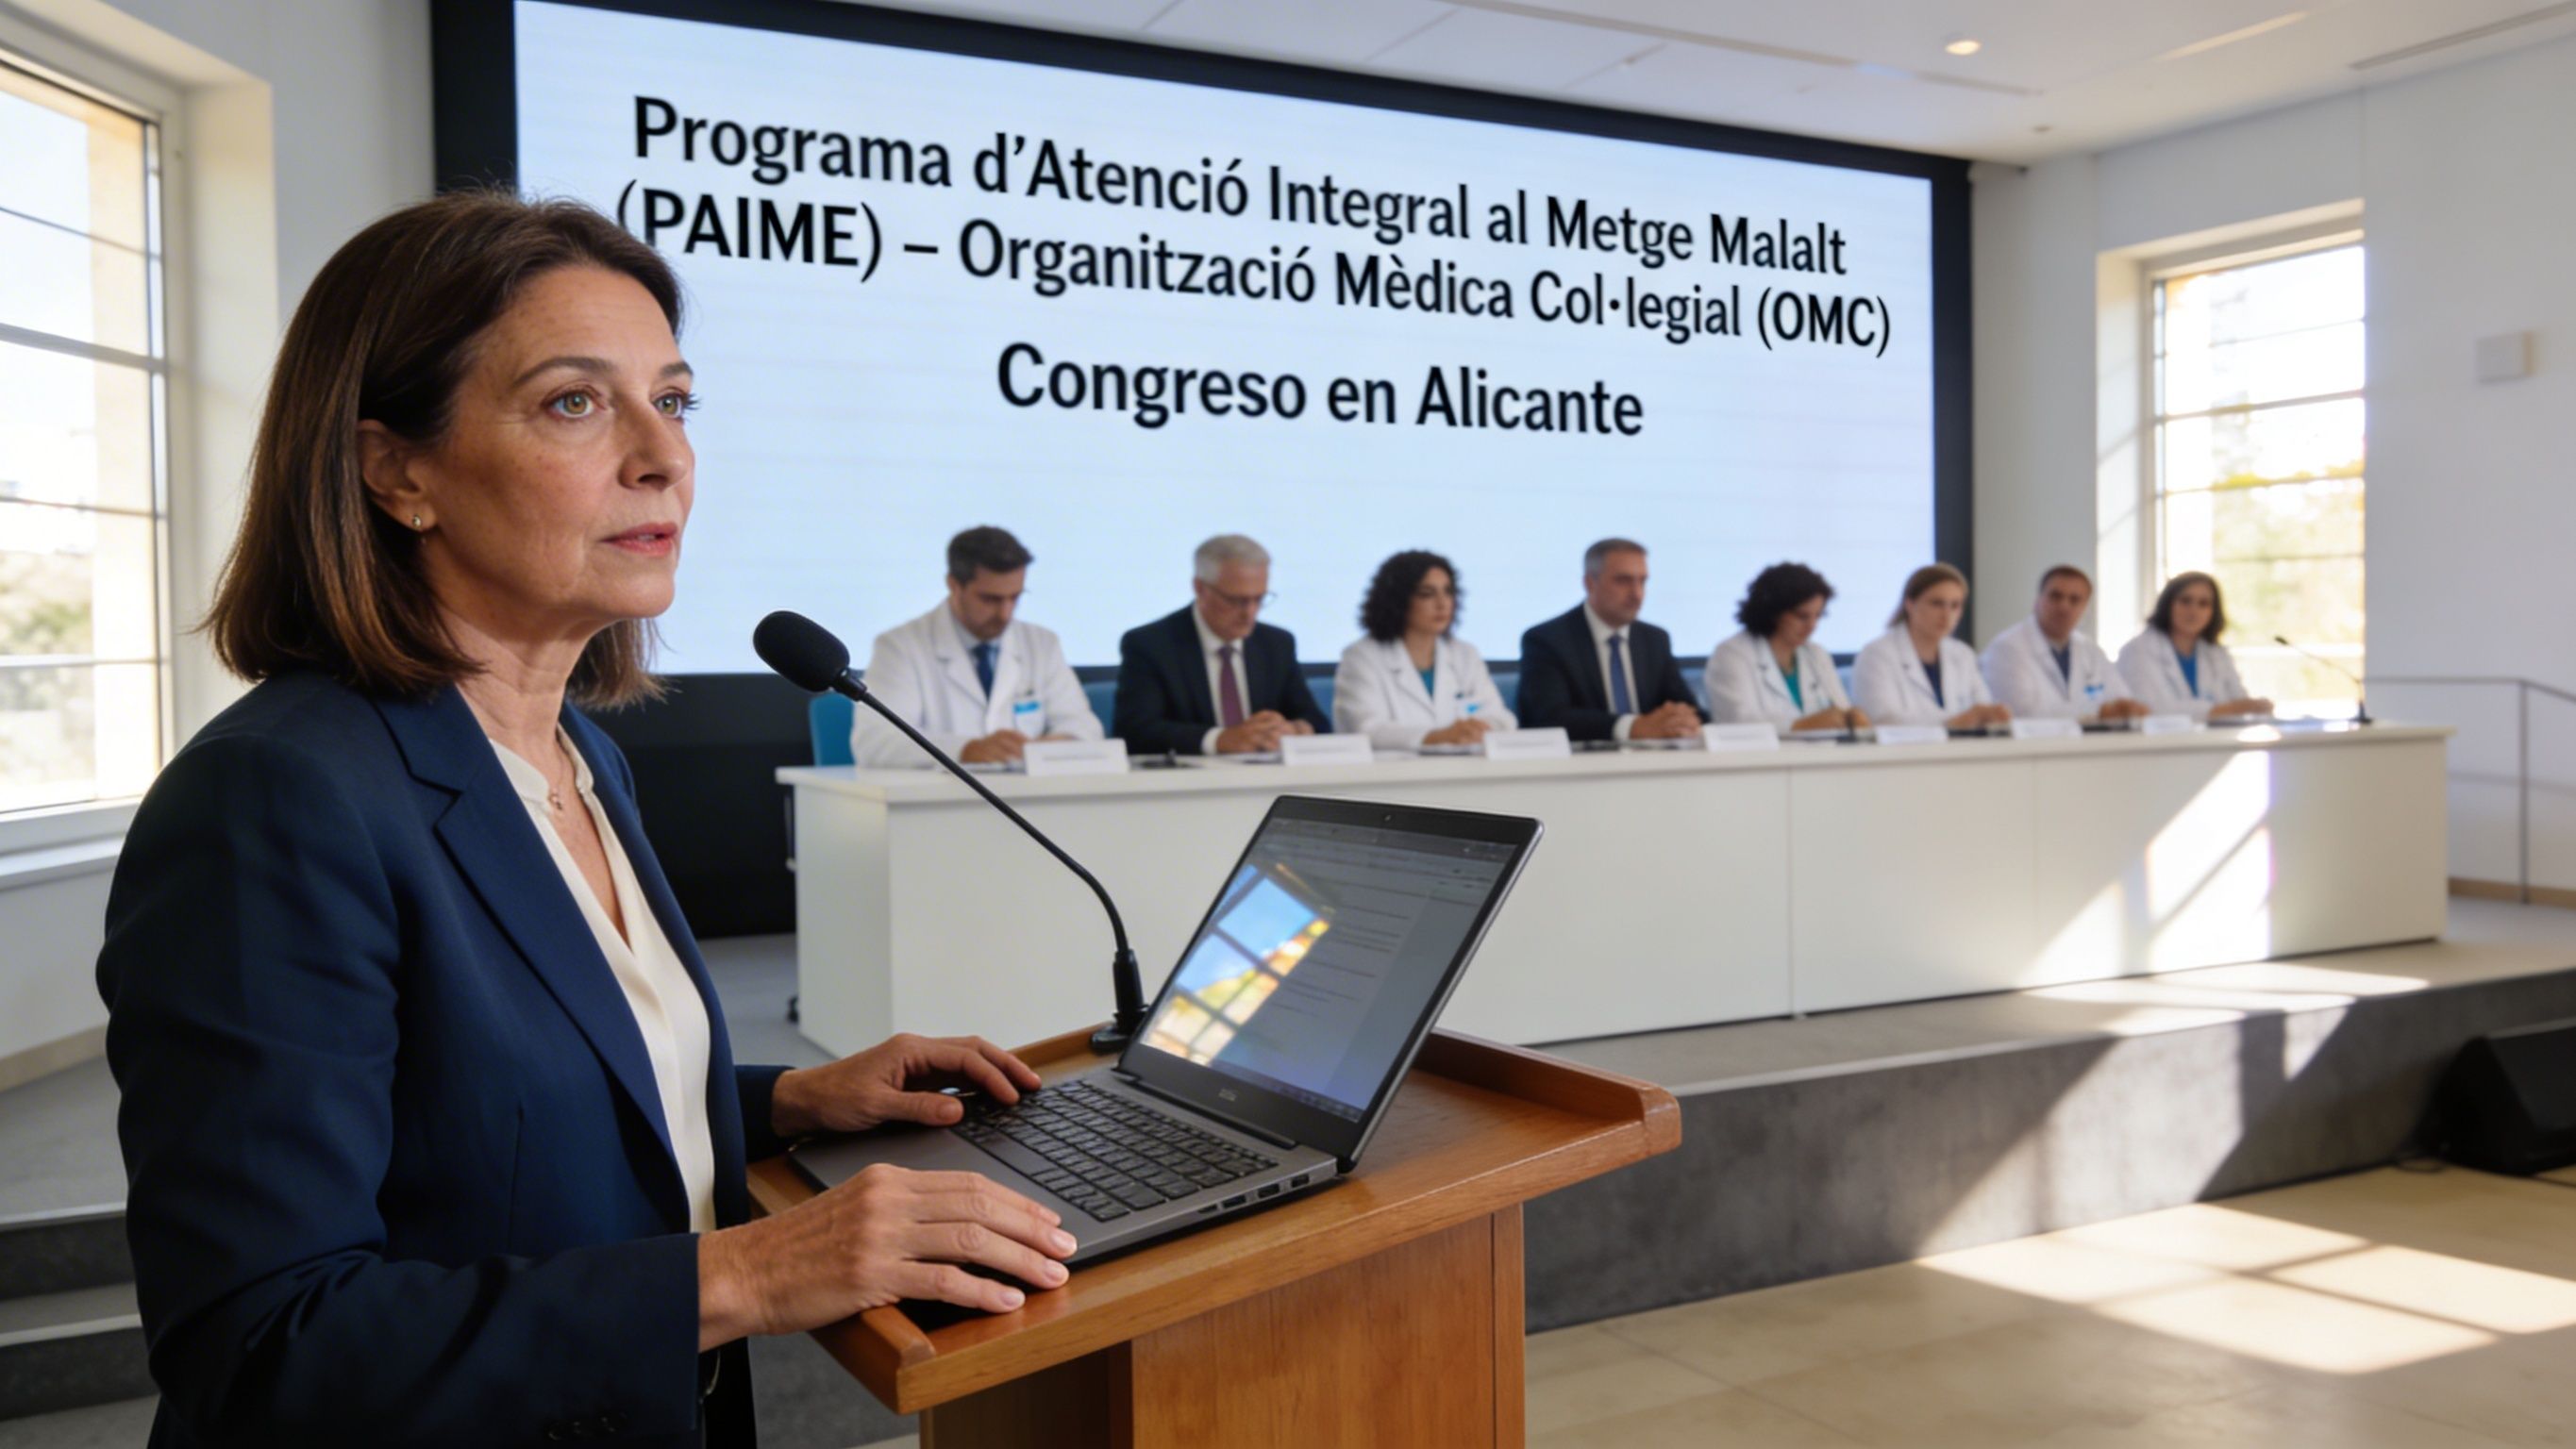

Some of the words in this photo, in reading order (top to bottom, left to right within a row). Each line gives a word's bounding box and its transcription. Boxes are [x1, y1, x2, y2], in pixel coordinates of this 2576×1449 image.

[617, 178, 882, 283] (PAIME)
[959, 218, 1316, 303] Organització
[1334, 251, 1514, 319] Mèdica
[1756, 286, 1891, 358] (OMC)
[633, 93, 952, 188] Programa
[1269, 165, 1470, 246] Integral
[1487, 189, 1529, 245] al
[1547, 195, 1694, 270] Metge
[1710, 212, 1848, 275] Malalt
[997, 341, 1307, 430] Congreso
[1327, 376, 1397, 425] en
[1414, 365, 1644, 437] Alicante
